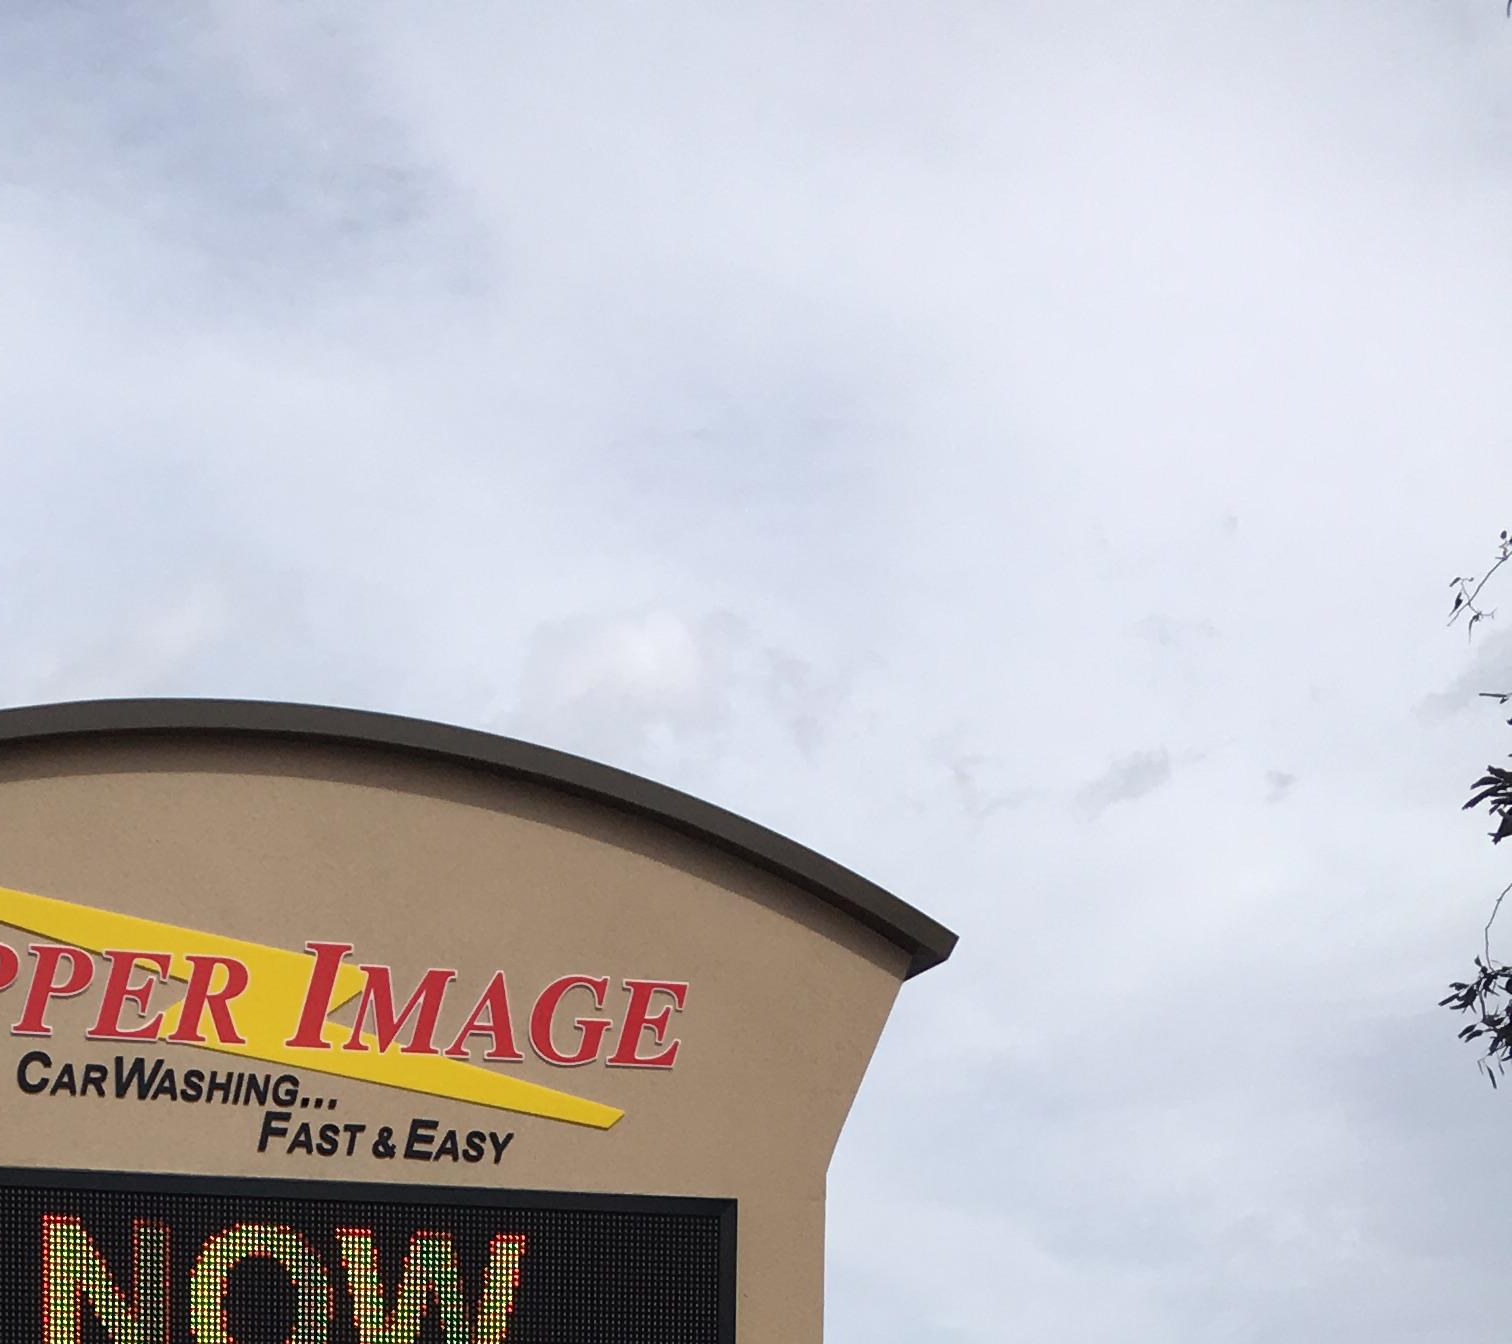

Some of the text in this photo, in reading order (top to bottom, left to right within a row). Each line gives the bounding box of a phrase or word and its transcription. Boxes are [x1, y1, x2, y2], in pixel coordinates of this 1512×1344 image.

[285, 941, 689, 1069] IMAGE
[257, 1110, 515, 1165] FAST & EASY
